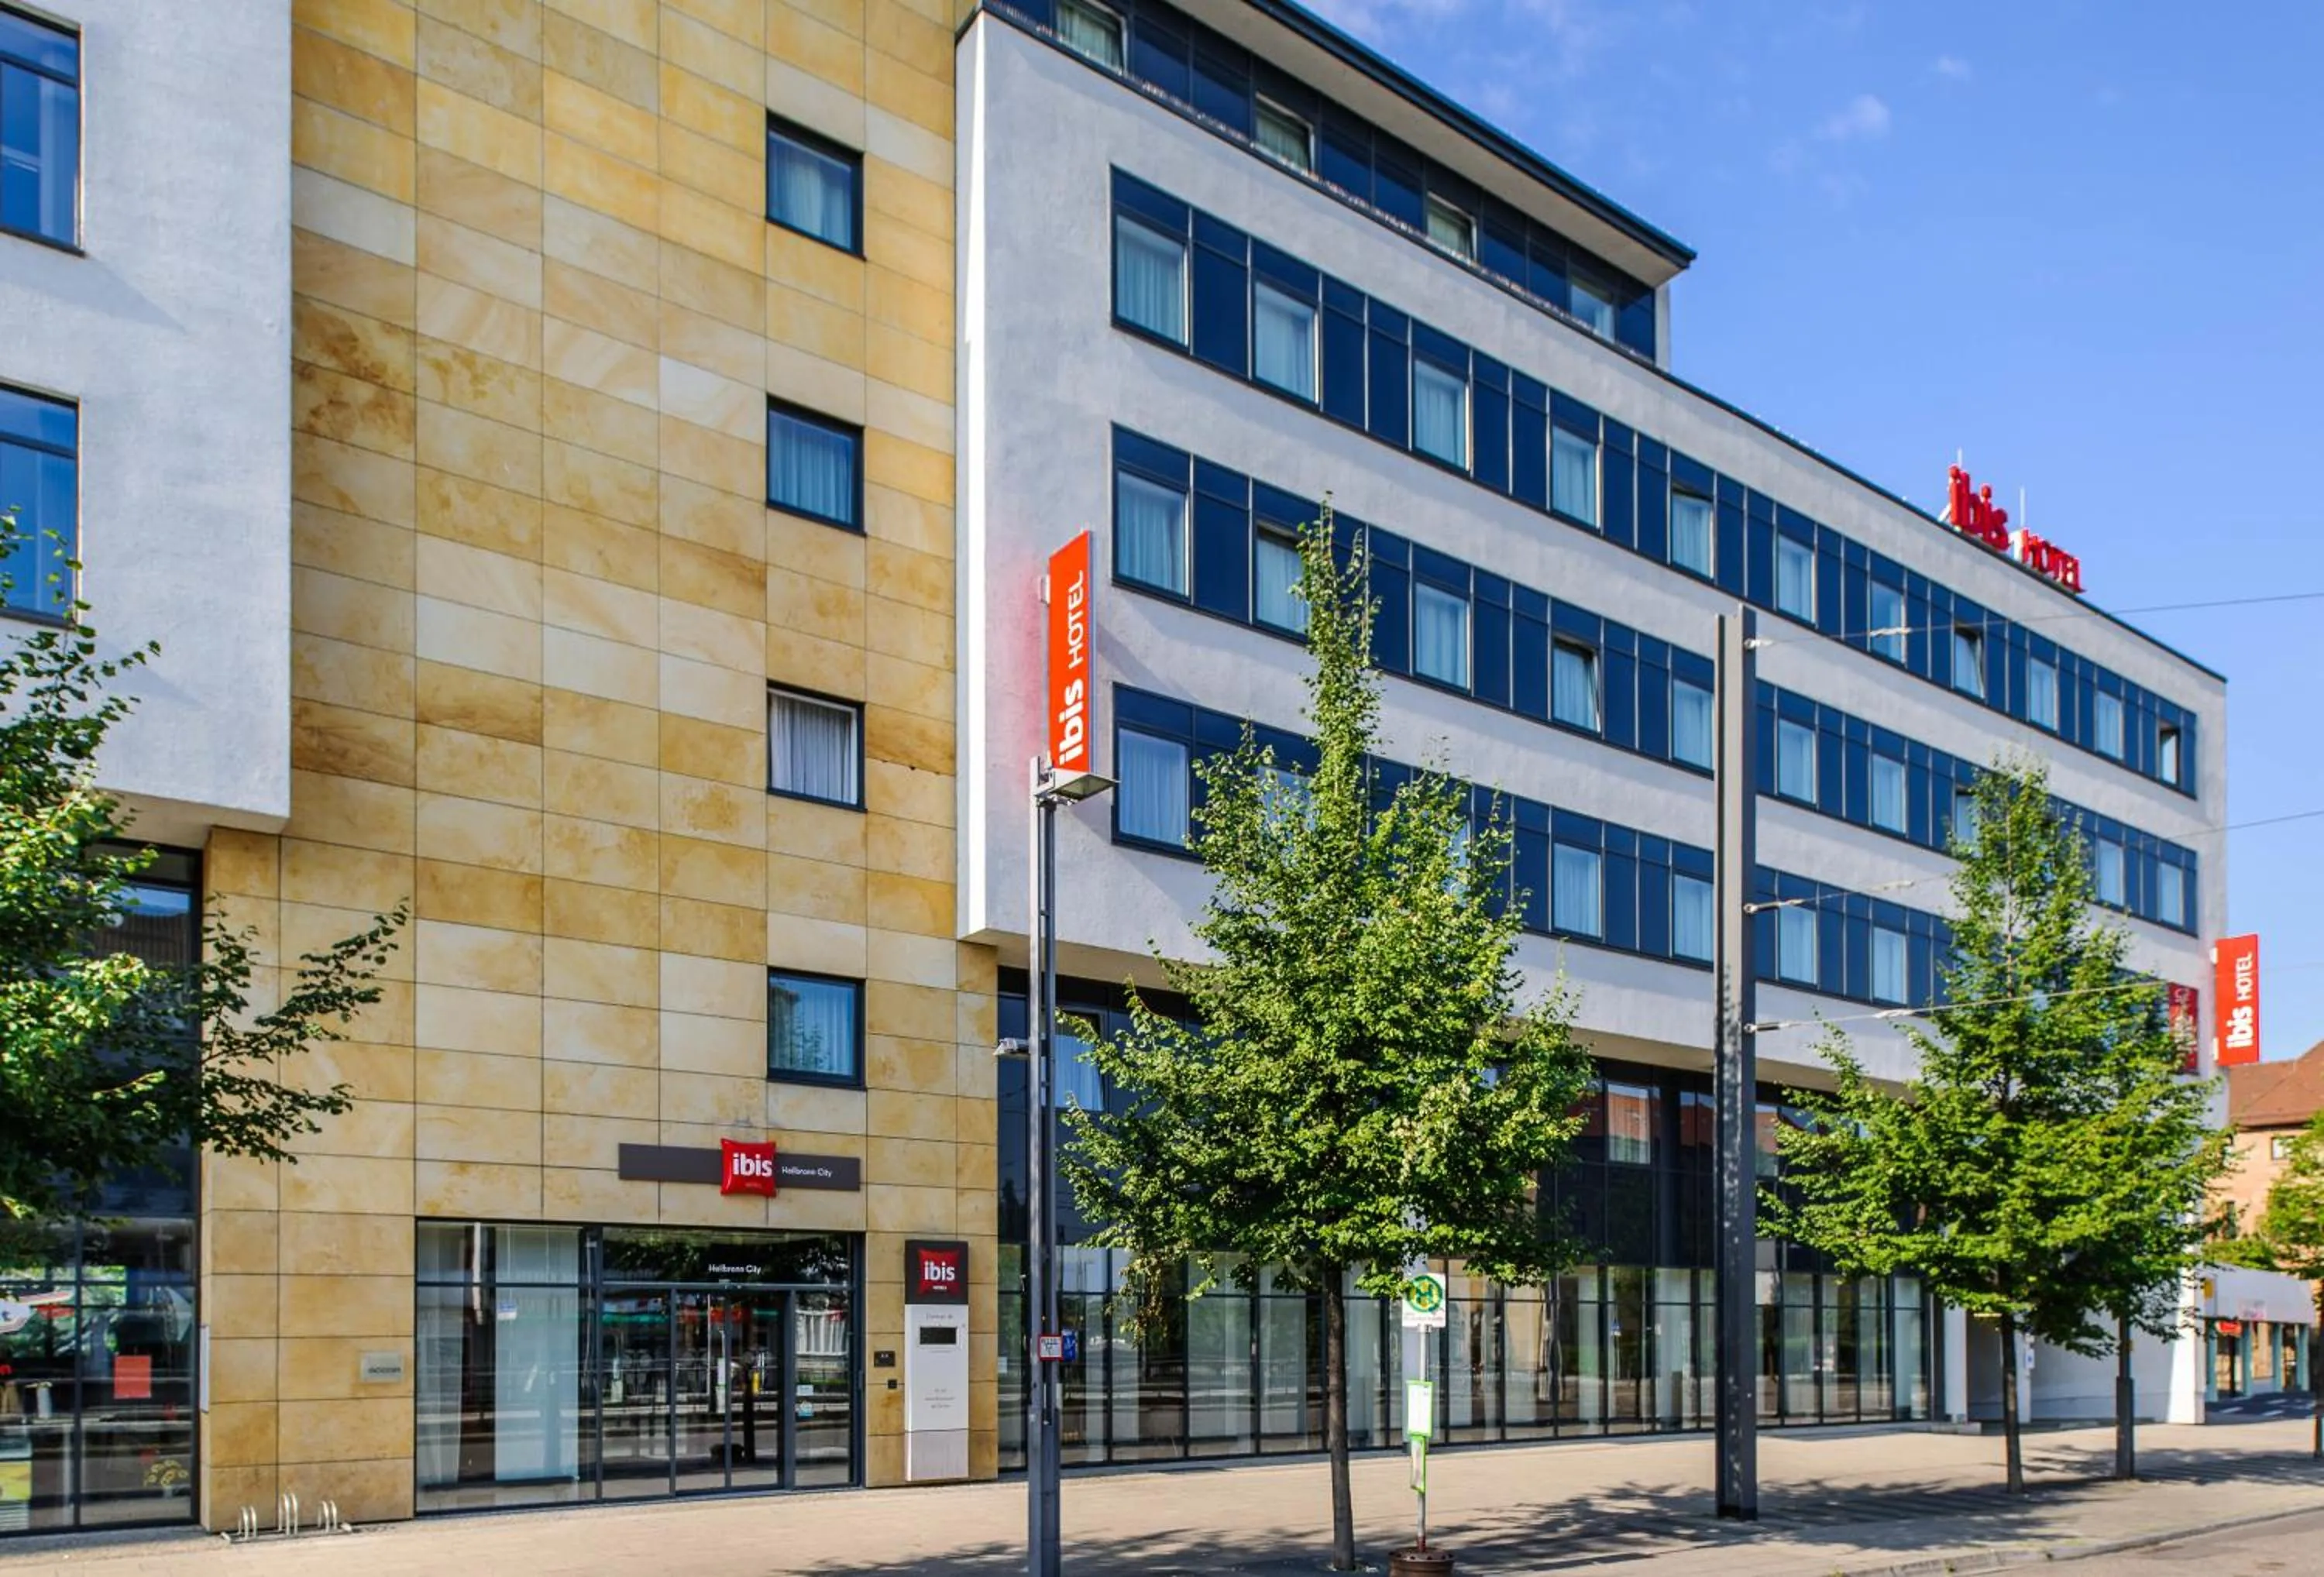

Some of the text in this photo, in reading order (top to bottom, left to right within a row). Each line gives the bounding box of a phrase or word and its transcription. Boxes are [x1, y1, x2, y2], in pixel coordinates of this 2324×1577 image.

[1948, 465, 2009, 551] ibis
[1058, 569, 1084, 766] ibis HOTEL
[2226, 952, 2254, 1049] ibis HOTEL
[732, 1152, 773, 1177] ibis
[924, 1260, 956, 1281] ibis
